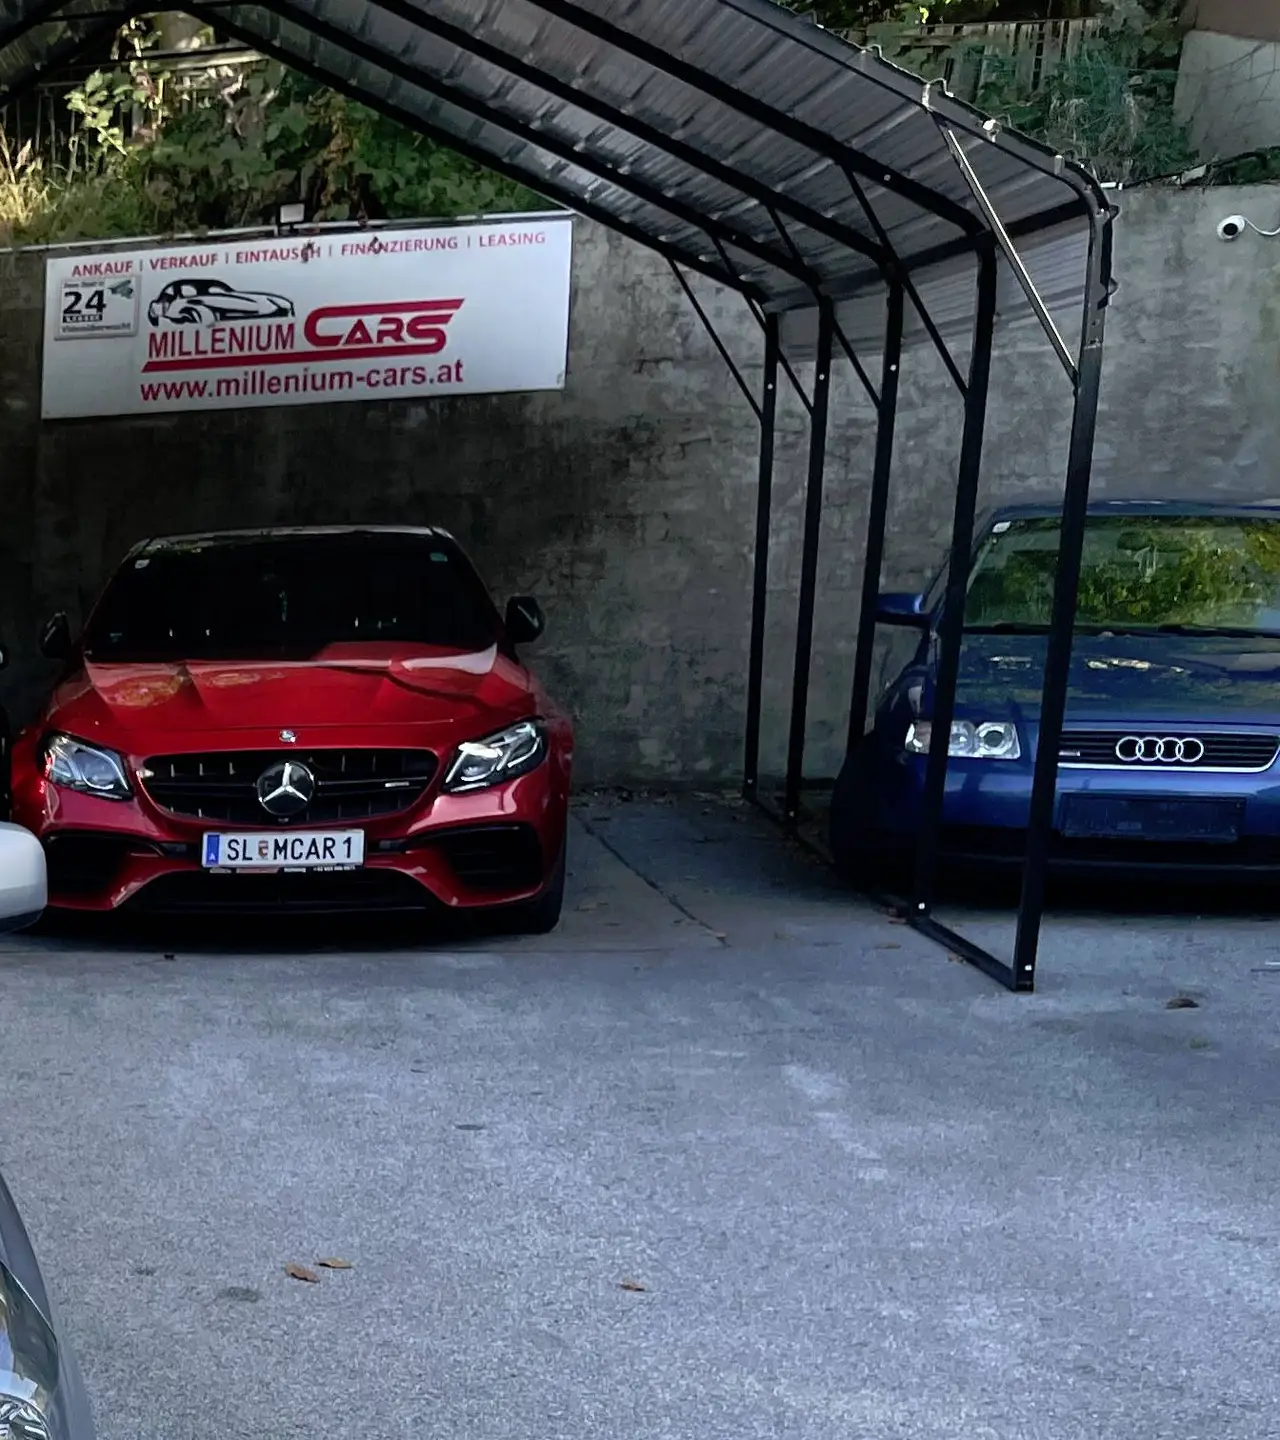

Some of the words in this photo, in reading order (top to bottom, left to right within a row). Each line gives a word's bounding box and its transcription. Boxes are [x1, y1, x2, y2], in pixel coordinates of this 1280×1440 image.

[71, 260, 134, 278] ANKAUF
[149, 252, 219, 271] VERKAUF
[341, 236, 458, 256] FINANZIERUNG
[479, 231, 546, 247] LEASING
[63, 290, 107, 314] 24
[147, 323, 296, 358] MILLENIUM
[303, 298, 466, 354] CARS
[140, 359, 464, 401] www.millenium-cars.at
[226, 838, 253, 861] SL
